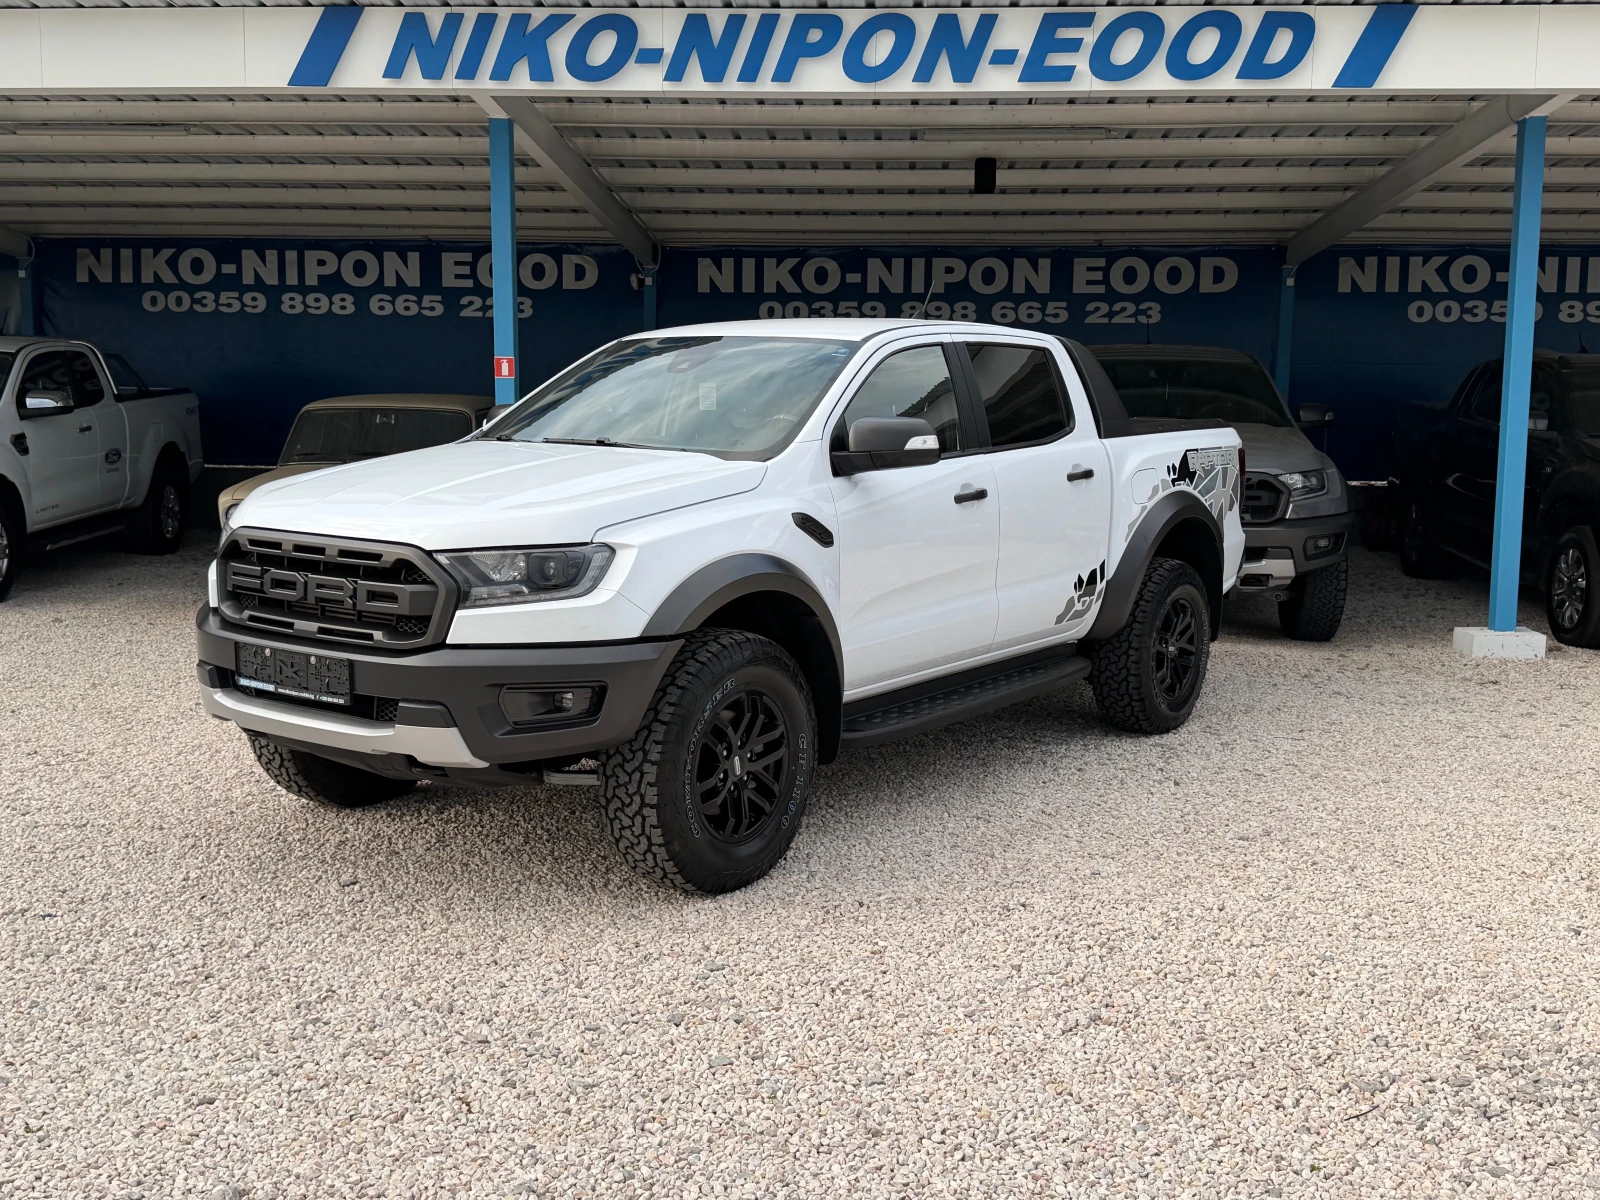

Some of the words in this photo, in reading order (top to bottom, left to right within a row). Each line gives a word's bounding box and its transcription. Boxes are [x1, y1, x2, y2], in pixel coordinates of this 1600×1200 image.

[382, 10, 1316, 83] NIKO-NIPON-EOOD
[76, 248, 421, 287] NIKO-NIPON
[697, 256, 1051, 294] NIKO-NIPON
[1072, 256, 1239, 294] EOOD
[141, 290, 267, 313] 00359
[280, 292, 355, 315] 898
[369, 293, 444, 317] 665
[759, 301, 886, 318] 00359
[901, 301, 977, 322] 898
[991, 301, 1069, 324] 665
[1084, 301, 1162, 324] 223
[1187, 449, 1236, 473] RAPTOR
[227, 562, 411, 615] FORD
